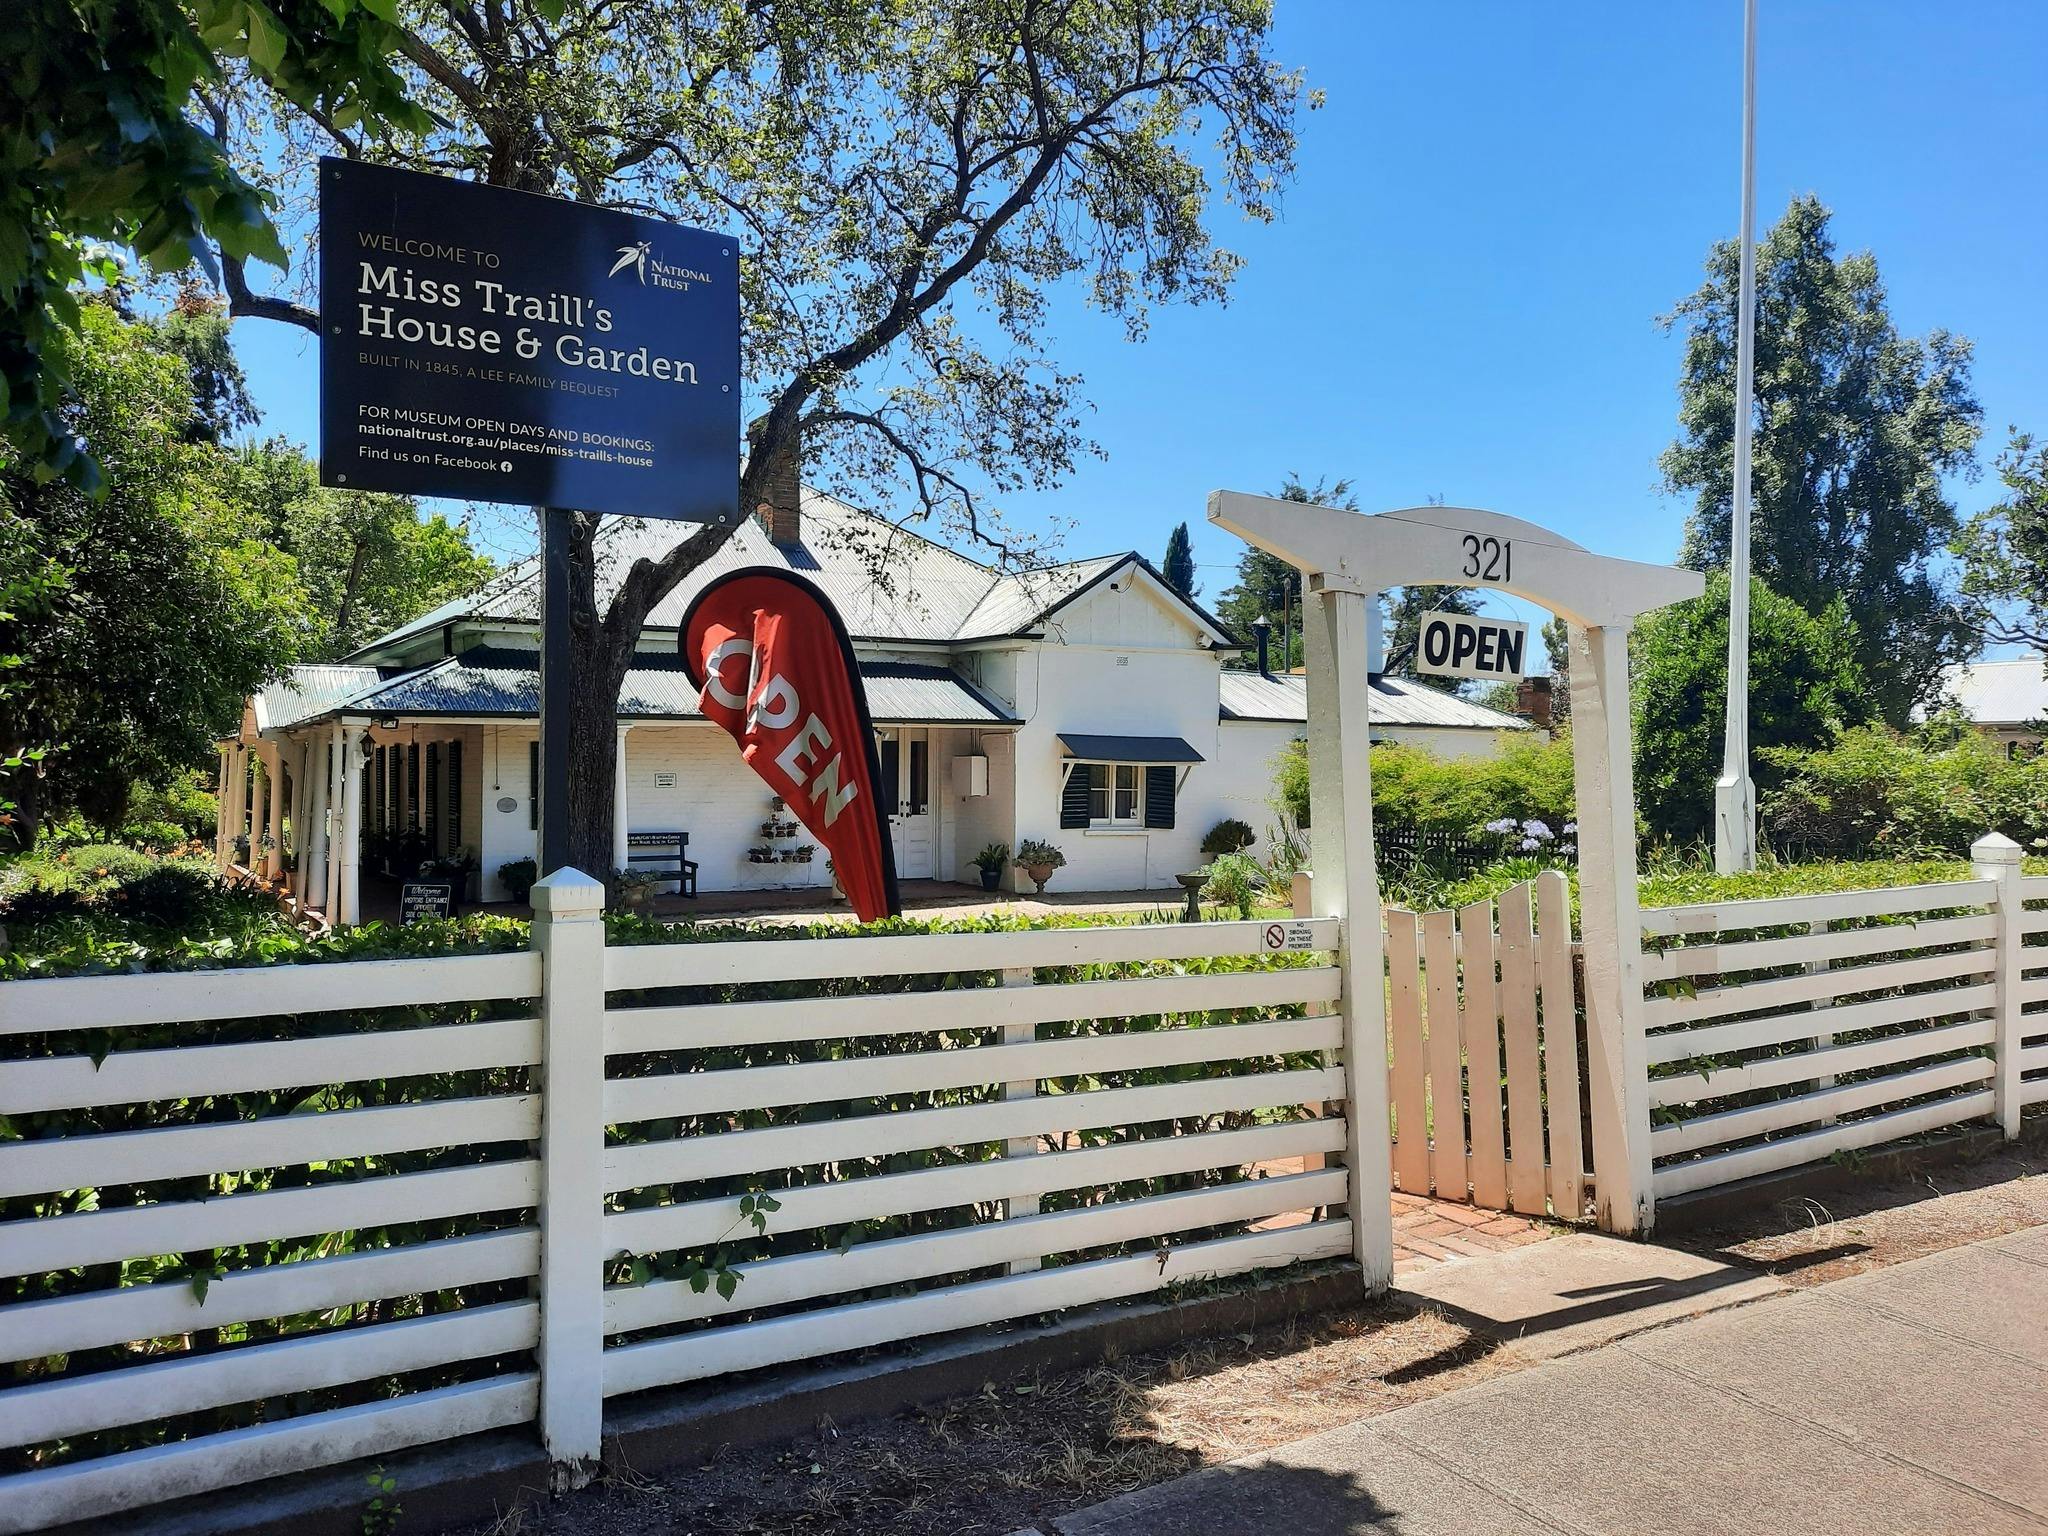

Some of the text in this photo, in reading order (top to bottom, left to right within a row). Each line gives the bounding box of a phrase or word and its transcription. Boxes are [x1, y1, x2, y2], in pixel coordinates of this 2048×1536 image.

[359, 232, 500, 268] WELCOME TO
[651, 260, 712, 283] NATIONAL
[358, 262, 613, 331] Miss Traill's
[651, 273, 690, 291] TRUST
[359, 303, 698, 385] House & Garden
[359, 352, 620, 398] BUILT IN 1845, A LEE FAMILY BEQUEST
[359, 405, 655, 452] FOR MUSEUM OPEN DAYS AND BOOKINGS:
[359, 424, 653, 467] nationaltrust.org.au/places/miss-traills-house
[359, 446, 389, 460] Find
[393, 452, 408, 461] us
[413, 454, 430, 464] on
[435, 454, 497, 470] Facebook
[1462, 534, 1511, 582] 321
[1424, 620, 1524, 674] OPEN
[705, 638, 859, 828] OPEN
